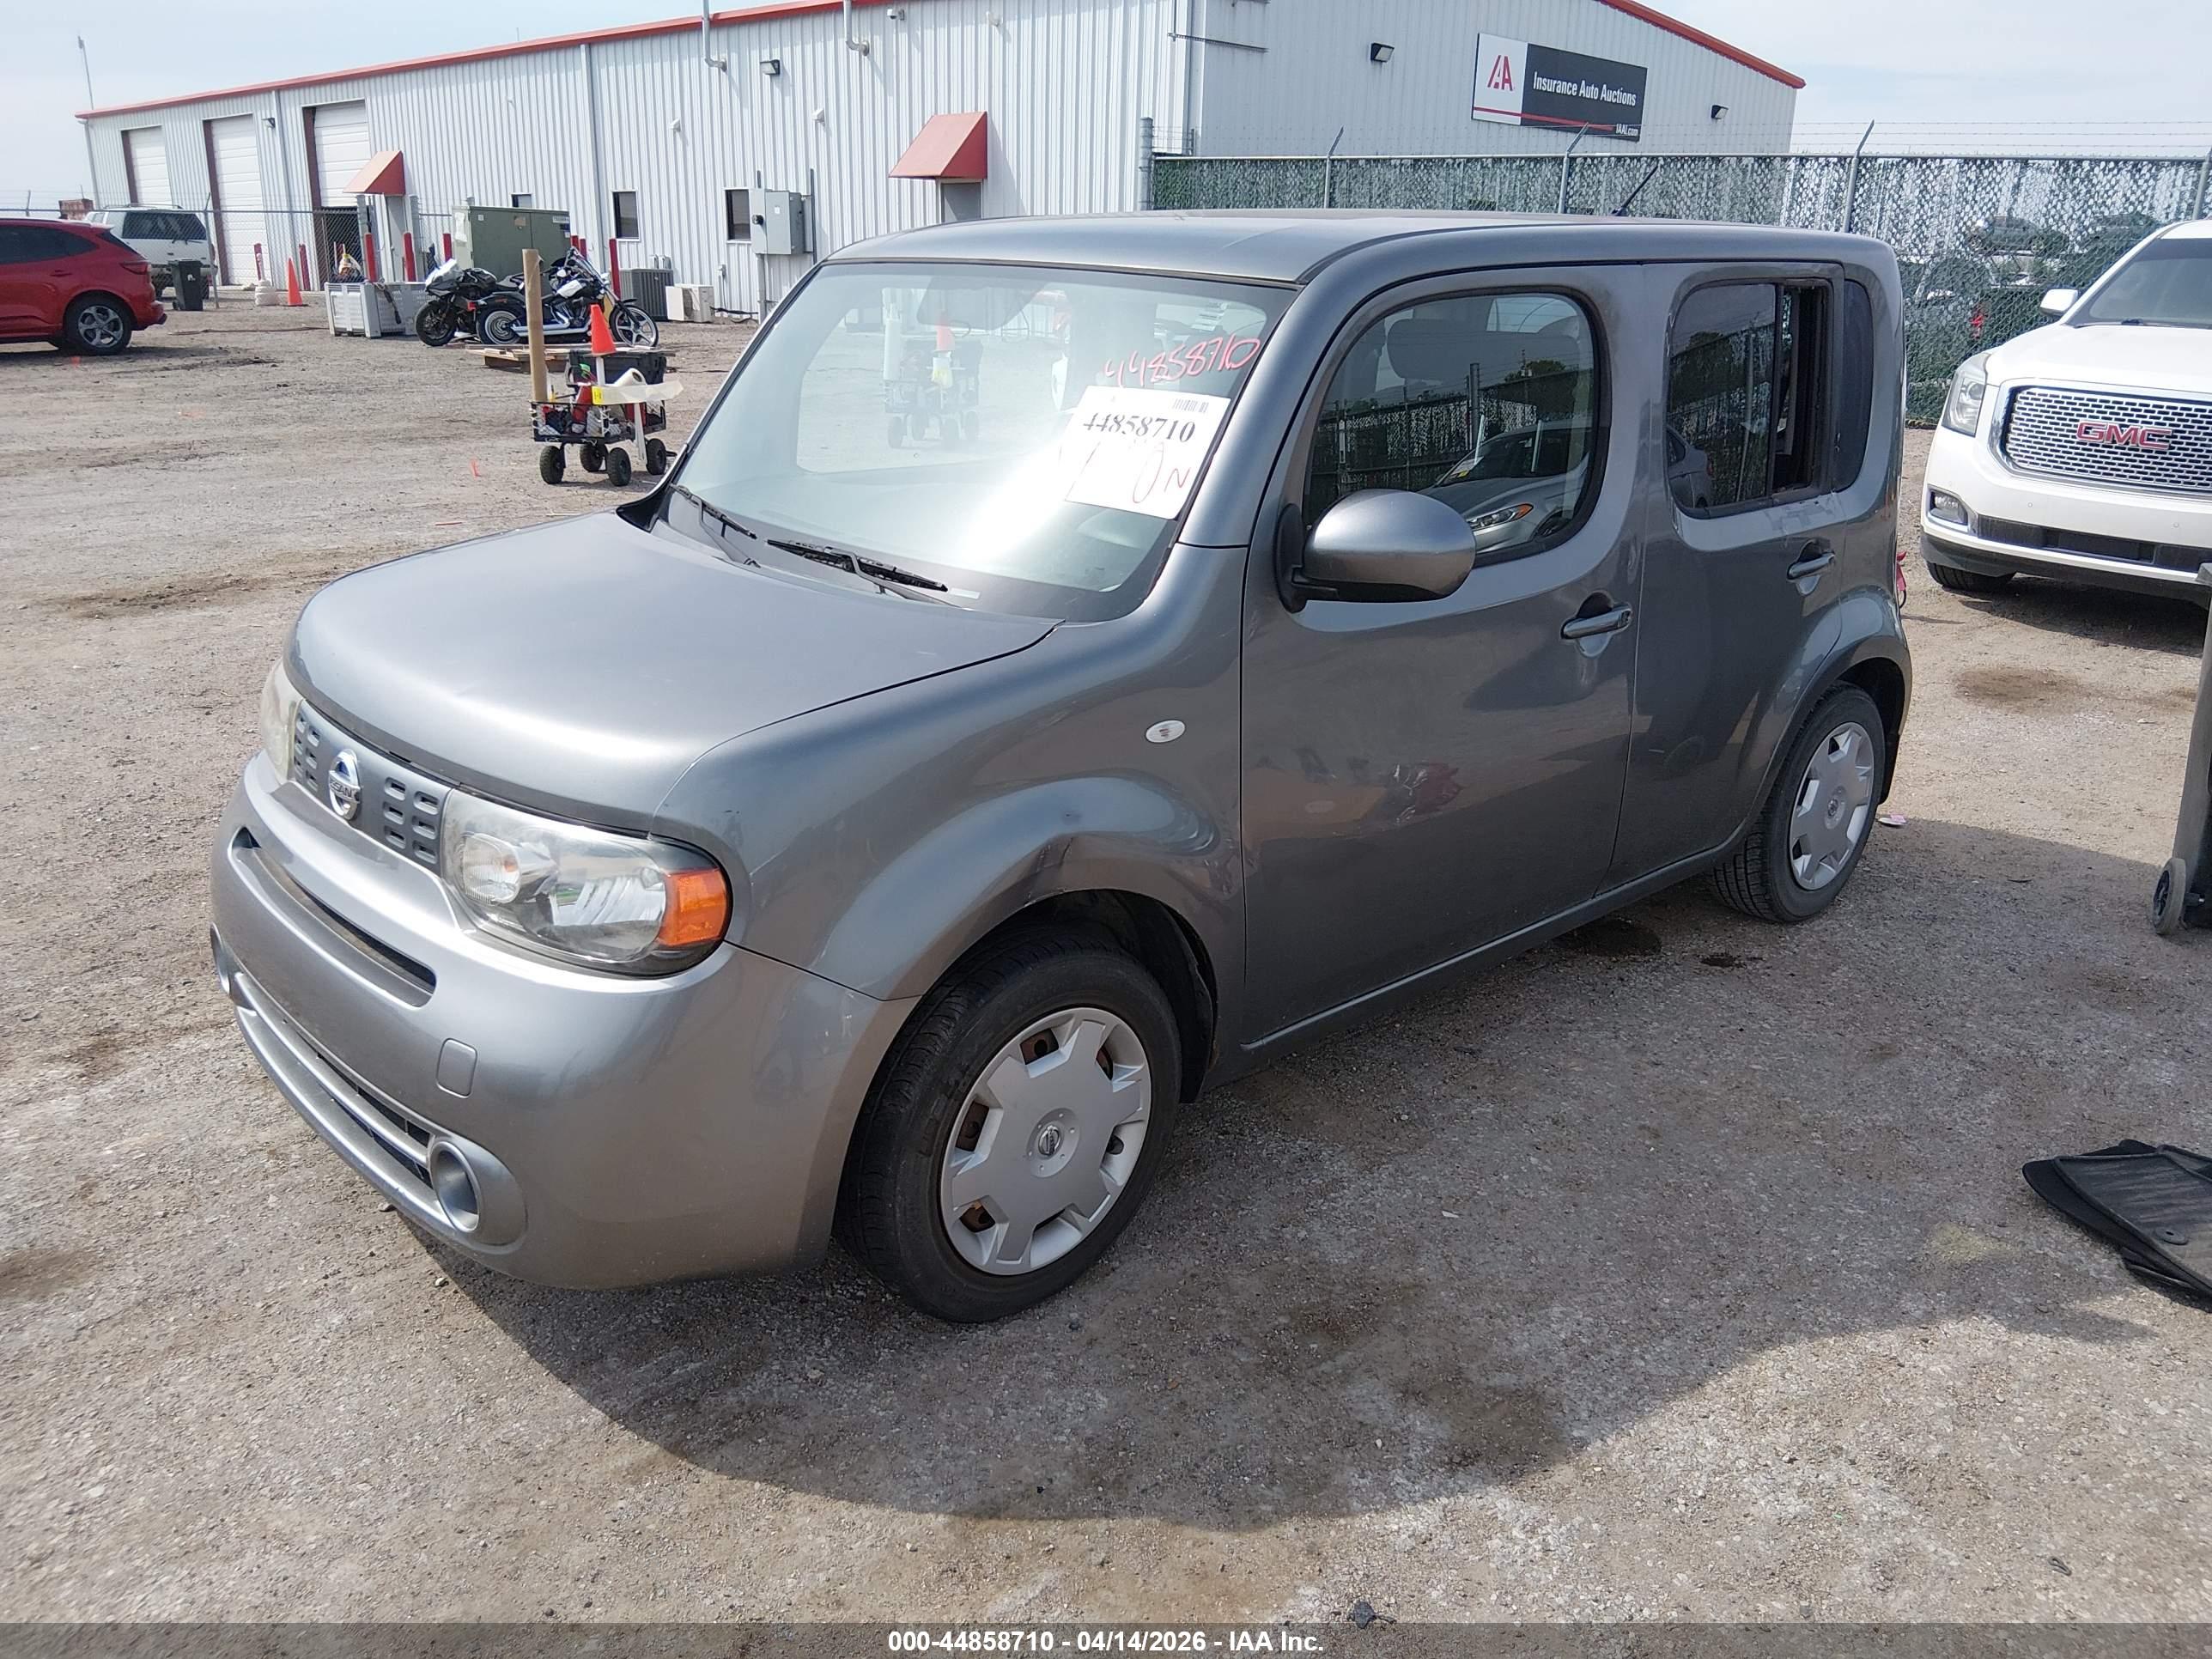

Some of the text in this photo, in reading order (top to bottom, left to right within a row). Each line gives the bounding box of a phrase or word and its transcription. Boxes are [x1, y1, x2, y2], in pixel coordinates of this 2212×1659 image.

[1533, 71, 1637, 106] Insurance Auto Auctions
[1103, 333, 1261, 388] 44858710
[1083, 412, 1196, 443] 44858710
[2076, 421, 2172, 450] GMC
